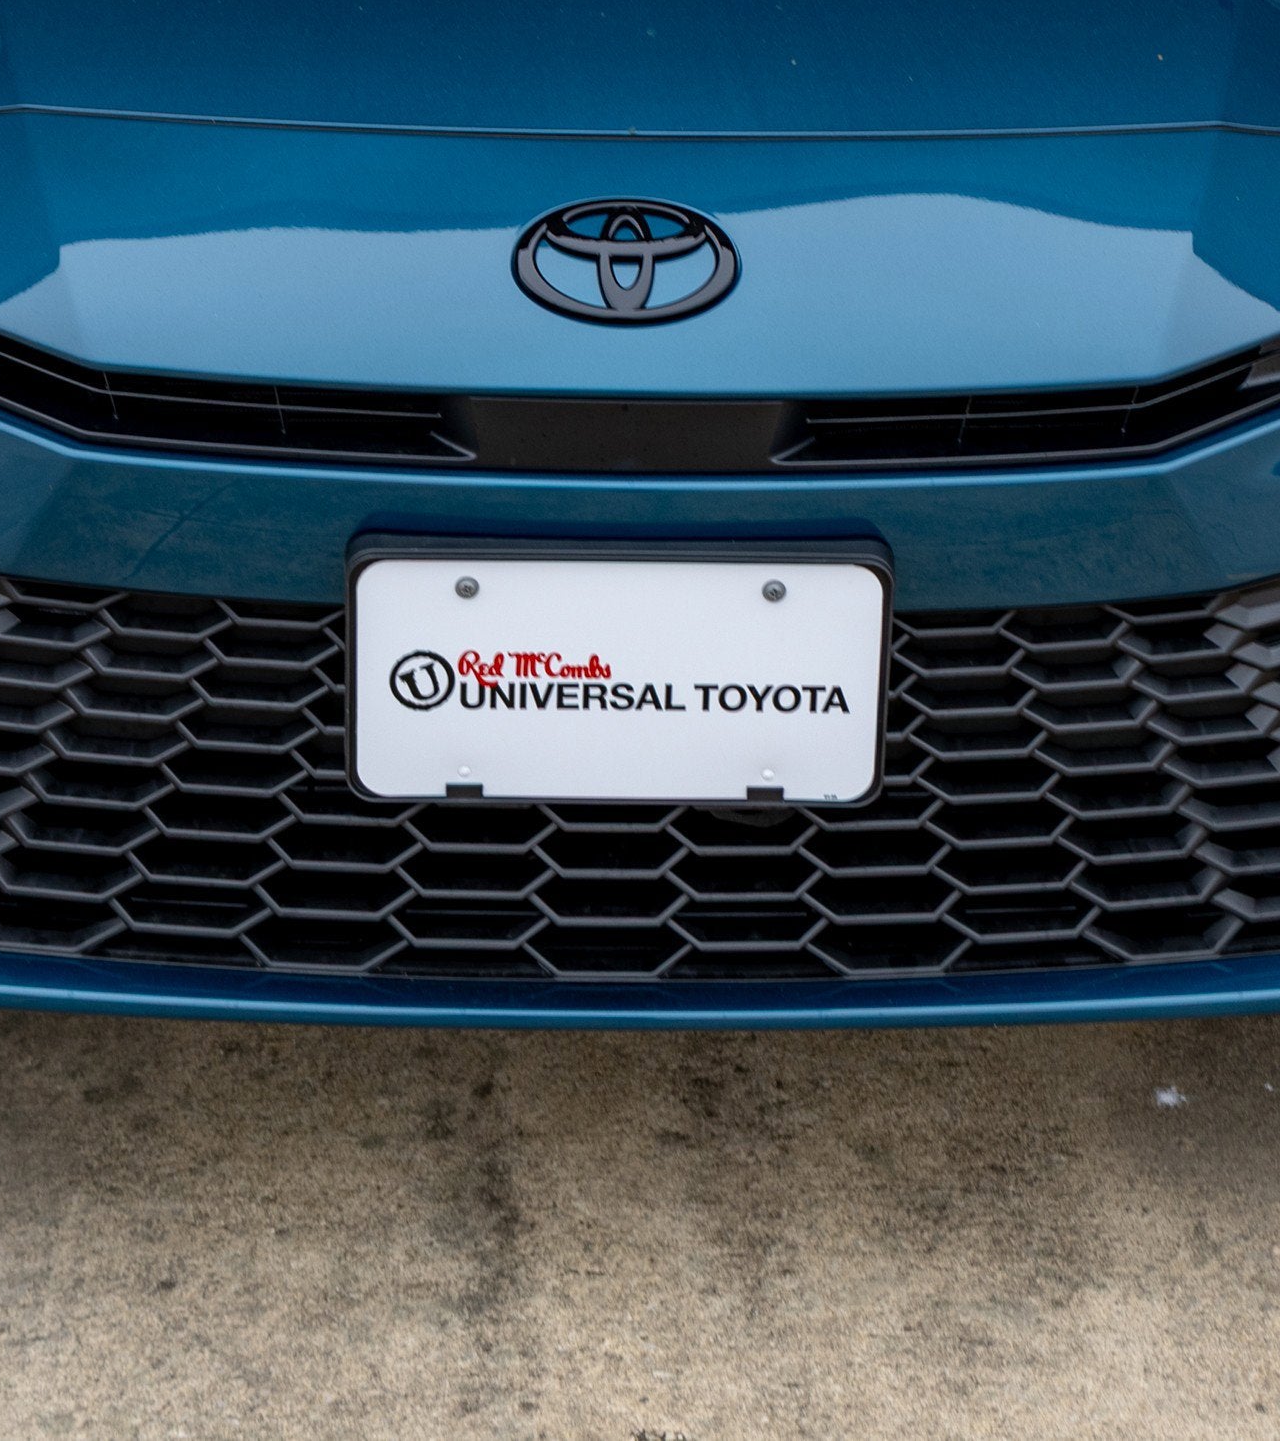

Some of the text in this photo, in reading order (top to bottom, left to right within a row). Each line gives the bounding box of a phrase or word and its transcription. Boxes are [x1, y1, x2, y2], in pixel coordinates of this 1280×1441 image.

[458, 650, 611, 688] Red McCombs
[459, 681, 851, 714] UNIVERSAL TOYOTA
